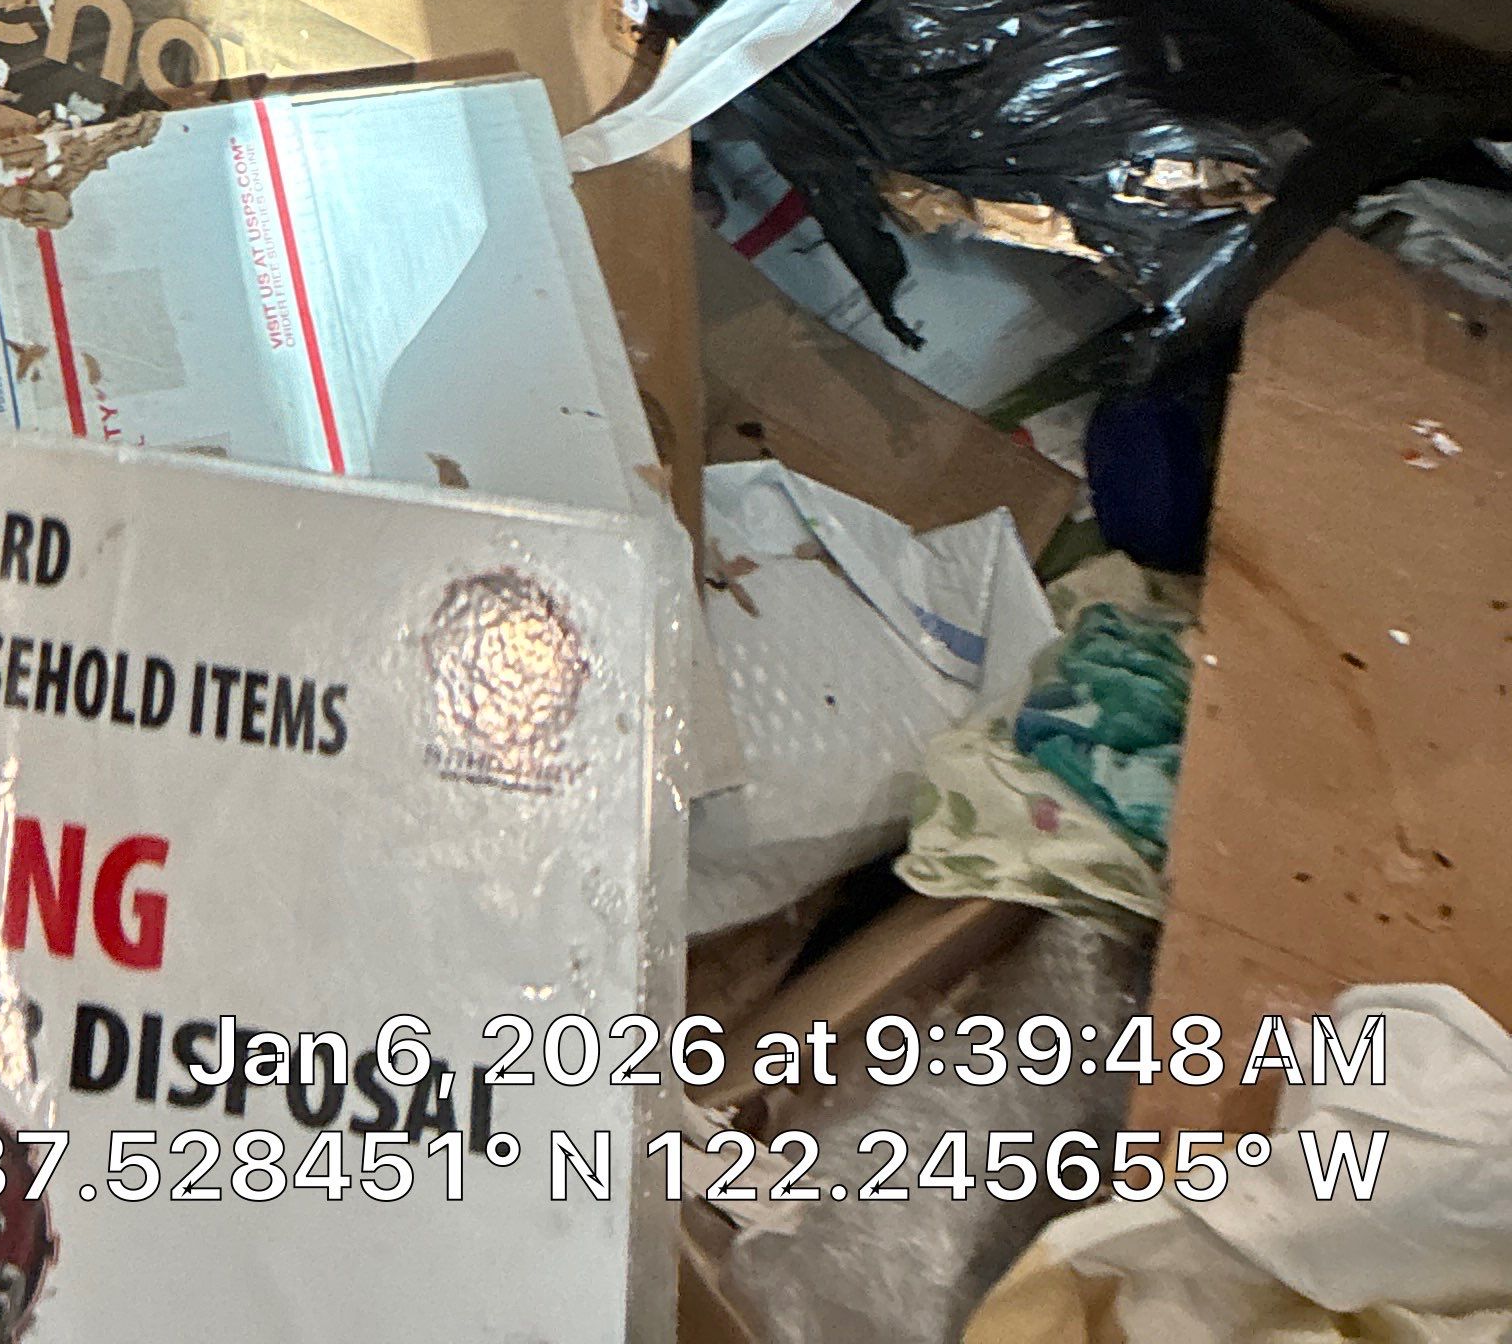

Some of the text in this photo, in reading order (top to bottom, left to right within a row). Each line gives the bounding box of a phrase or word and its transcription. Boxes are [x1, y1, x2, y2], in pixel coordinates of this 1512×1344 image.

[251, 247, 267, 266] AT
[257, 272, 274, 299] US
[263, 303, 284, 349] VISIT
[188, 661, 350, 758] ITEMS
